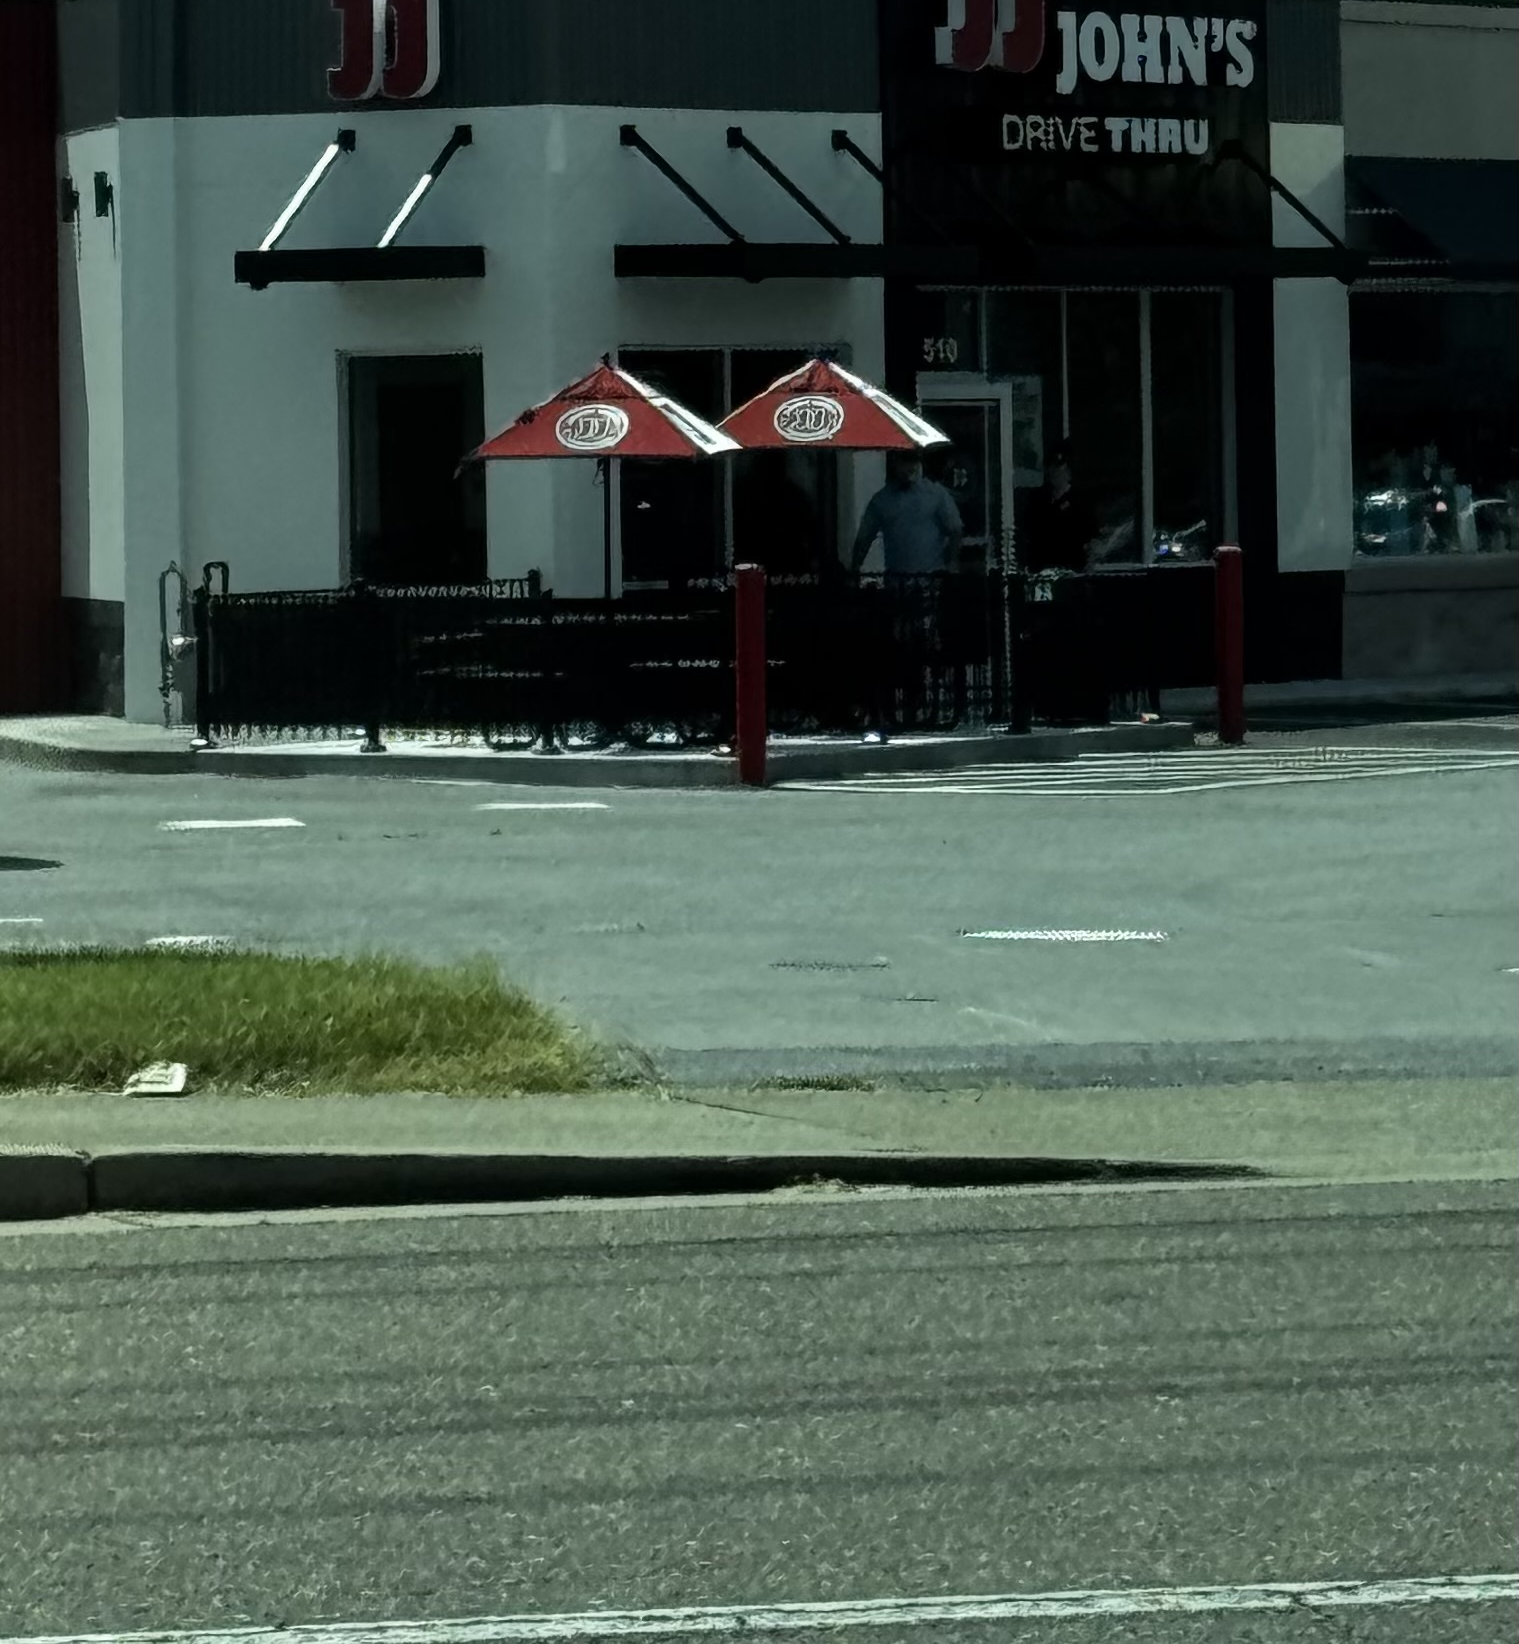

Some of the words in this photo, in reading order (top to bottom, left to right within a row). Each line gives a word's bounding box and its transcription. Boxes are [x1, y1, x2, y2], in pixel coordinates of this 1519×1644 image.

[1055, 11, 1258, 95] JOHN'S
[1002, 114, 1100, 152] DRIVE
[1104, 116, 1209, 155] THRU
[922, 335, 958, 363] 510
